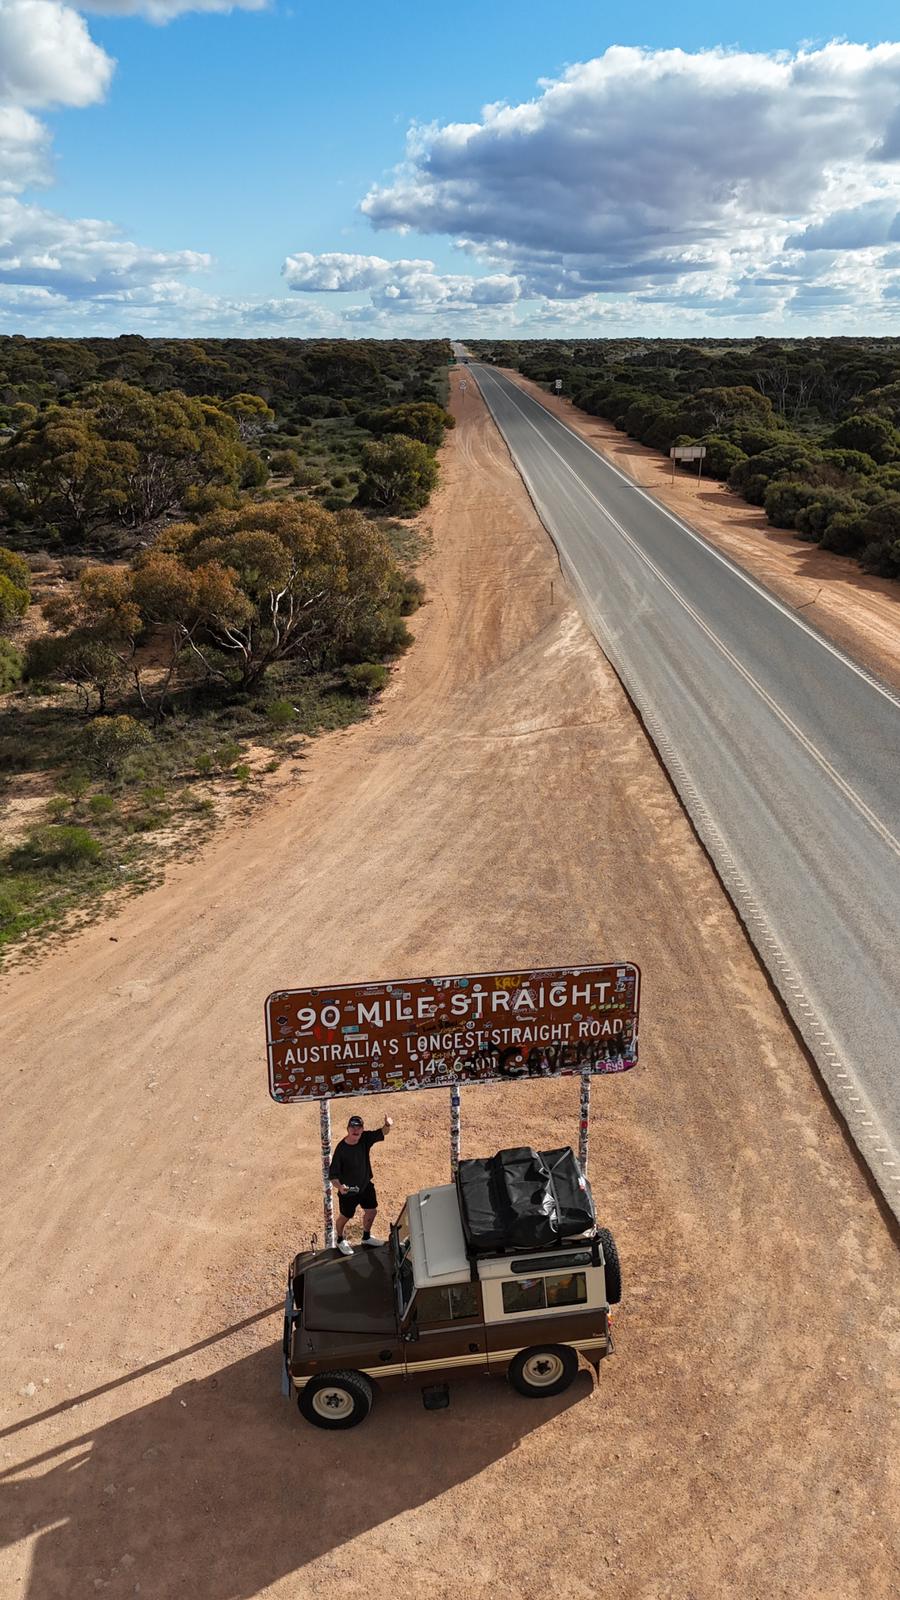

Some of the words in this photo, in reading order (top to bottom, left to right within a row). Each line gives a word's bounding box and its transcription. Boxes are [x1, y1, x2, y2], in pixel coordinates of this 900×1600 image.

[296, 1005, 341, 1030] 90
[357, 996, 435, 1025] MILE
[450, 982, 611, 1015] STRAIGHT
[285, 1039, 399, 1065] AUSTRALIA'S
[406, 1031, 484, 1053] LONGEST
[491, 1023, 572, 1044] STRAIGHT
[579, 1019, 624, 1037] ROAD
